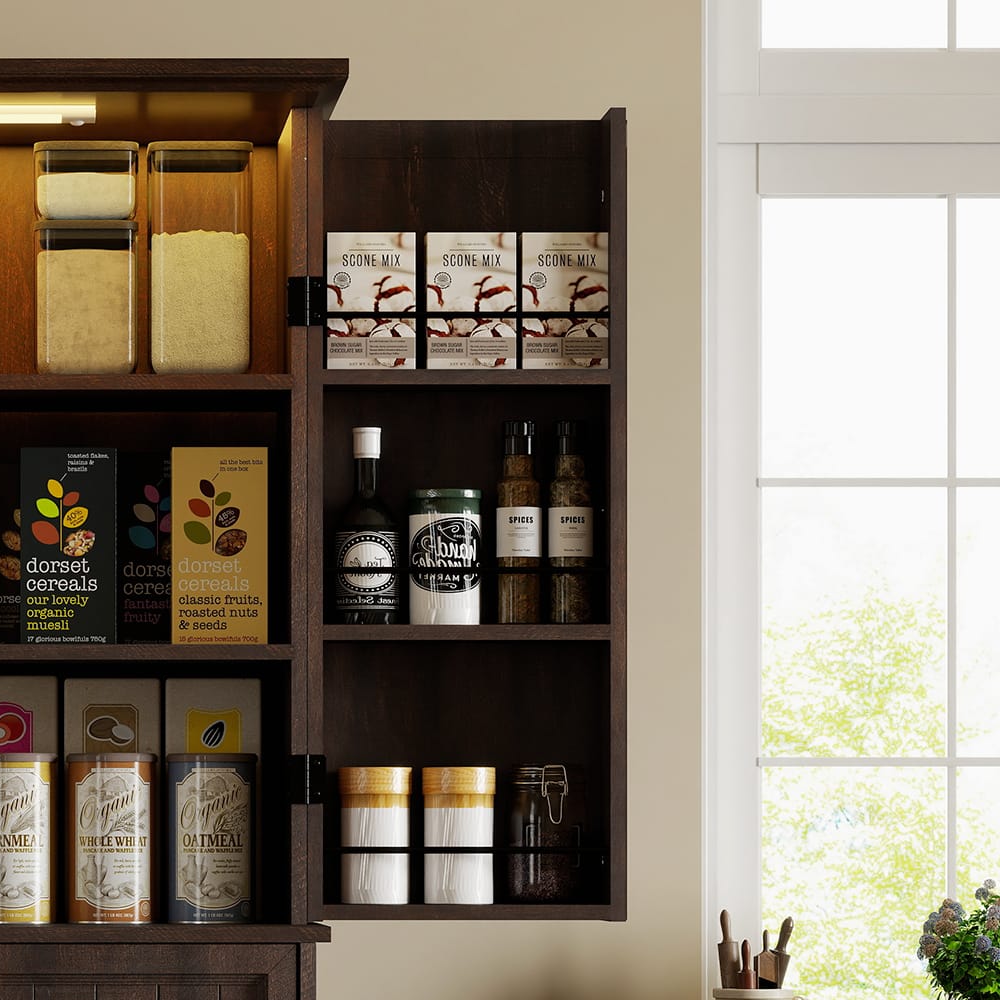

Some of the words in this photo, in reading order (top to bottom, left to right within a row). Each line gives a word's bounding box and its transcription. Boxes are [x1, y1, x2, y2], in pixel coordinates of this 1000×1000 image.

[342, 253, 377, 267] SCONE
[381, 253, 401, 267] MIX
[442, 253, 477, 267] SCONE
[481, 253, 501, 267] MIX
[537, 253, 572, 267] SCONE
[576, 253, 596, 267] MIX
[509, 516, 534, 524] SPICES
[560, 516, 585, 524] SPICES
[26, 557, 90, 573] dorset
[123, 562, 172, 577] dorse
[178, 557, 242, 574] dorset
[26, 576, 98, 592] cereals
[123, 581, 172, 596] cerea
[178, 576, 249, 592] cereals
[26, 596, 49, 605] our
[51, 594, 89, 607] lovely
[178, 595, 221, 605] classic
[224, 595, 263, 606] fruits,
[26, 607, 75, 620] organic
[123, 611, 161, 625] fruity
[178, 607, 226, 618] roasted
[229, 608, 258, 618] nuts
[26, 619, 70, 630] muesli
[178, 620, 189, 630] &
[193, 620, 228, 630] seeds
[80, 784, 140, 833] Organi
[79, 836, 113, 847] WHOLE
[183, 833, 243, 847] OATMEAL
